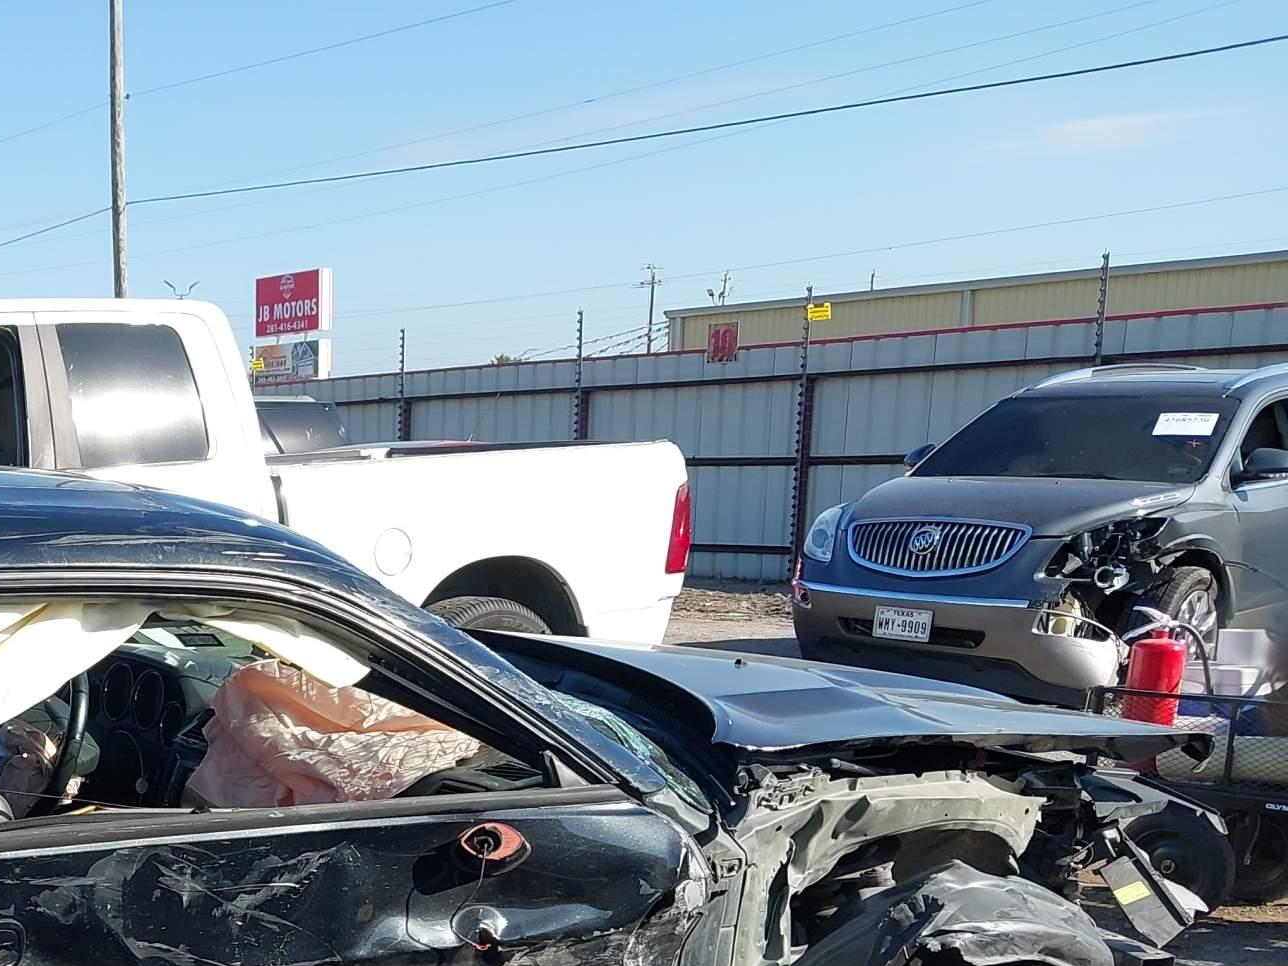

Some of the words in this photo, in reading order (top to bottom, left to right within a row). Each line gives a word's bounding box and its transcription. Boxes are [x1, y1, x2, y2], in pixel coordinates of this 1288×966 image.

[258, 304, 270, 323] JB
[273, 298, 318, 320] MOTORS
[892, 609, 914, 618] TEXAS
